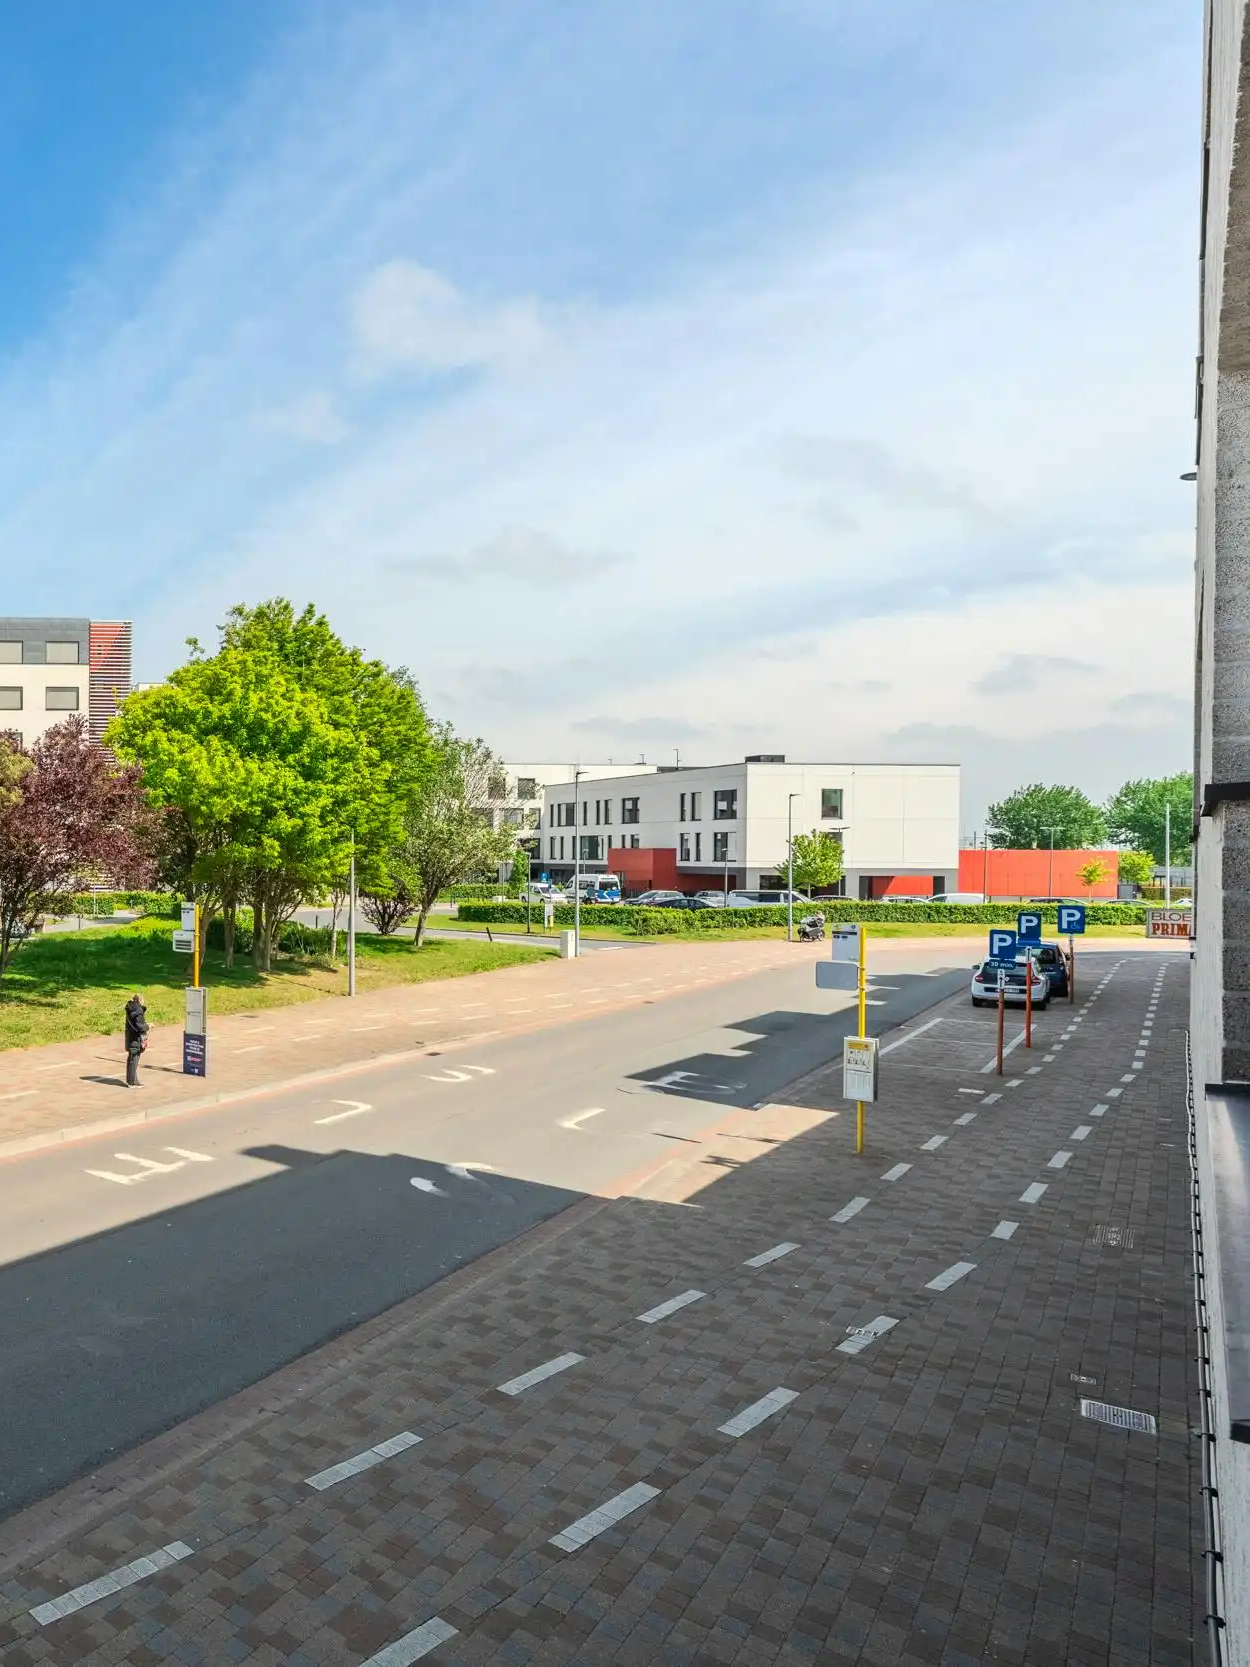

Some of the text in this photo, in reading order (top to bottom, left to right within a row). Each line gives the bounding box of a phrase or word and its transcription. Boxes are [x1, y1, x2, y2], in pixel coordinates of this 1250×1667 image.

[1020, 916, 1038, 934] P
[1061, 909, 1081, 929] P
[1152, 923, 1192, 937] PRIM
[993, 934, 1012, 955] P
